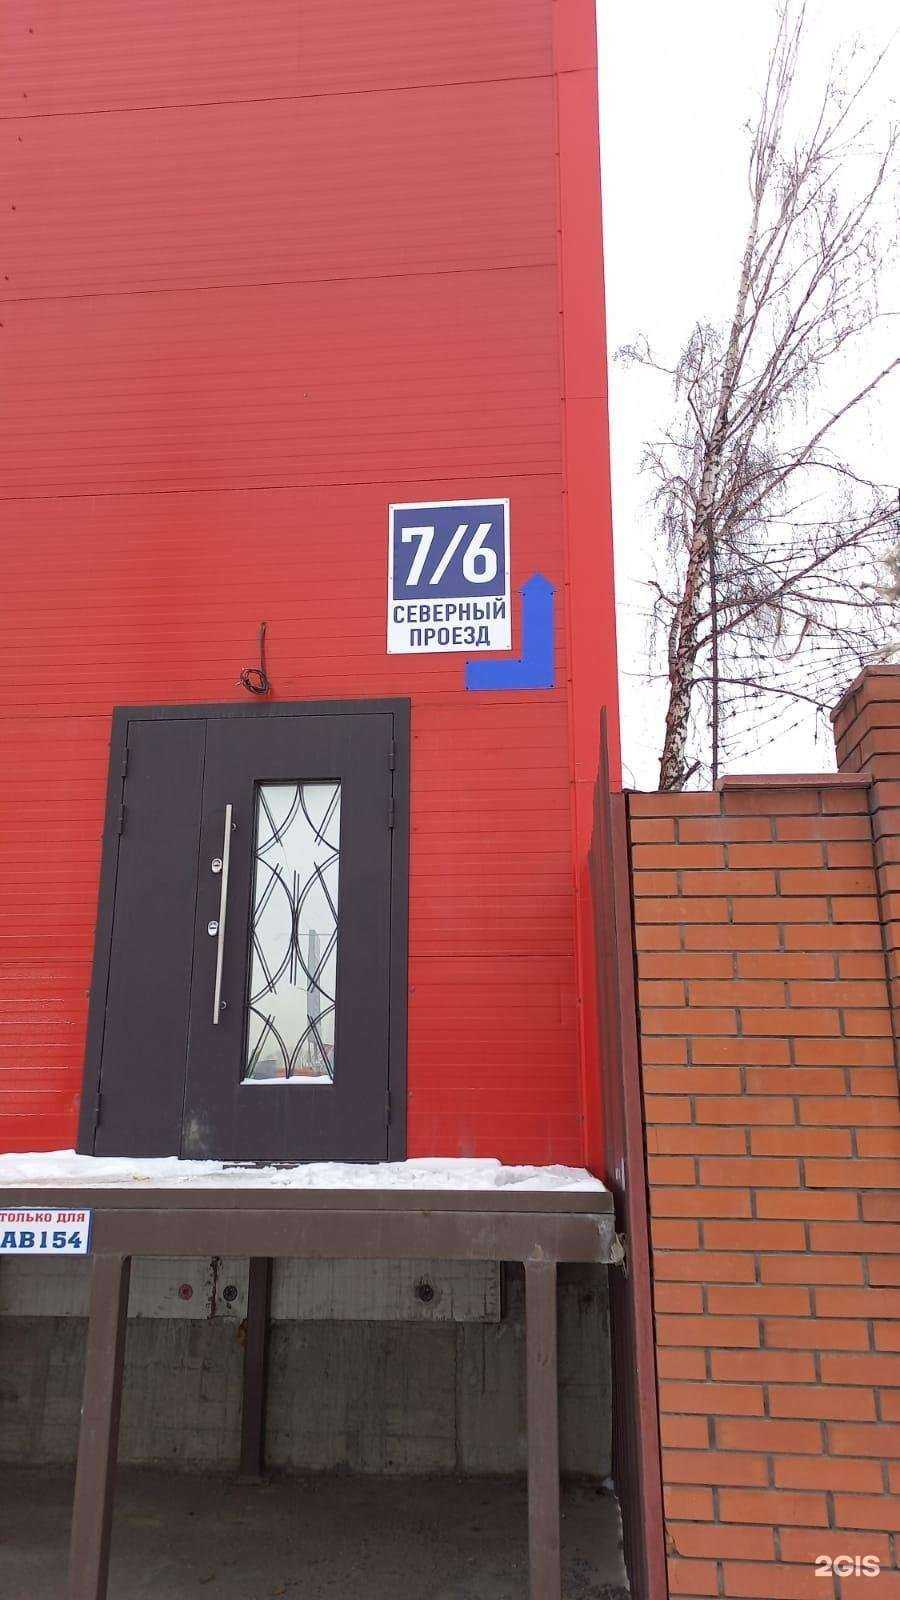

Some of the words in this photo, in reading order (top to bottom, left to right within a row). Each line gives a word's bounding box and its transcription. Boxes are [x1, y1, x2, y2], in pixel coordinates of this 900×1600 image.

[401, 523, 497, 586] 7/6
[393, 598, 506, 623] СЕВЕРНЫЙ
[409, 626, 490, 647] ПРОЕЗД
